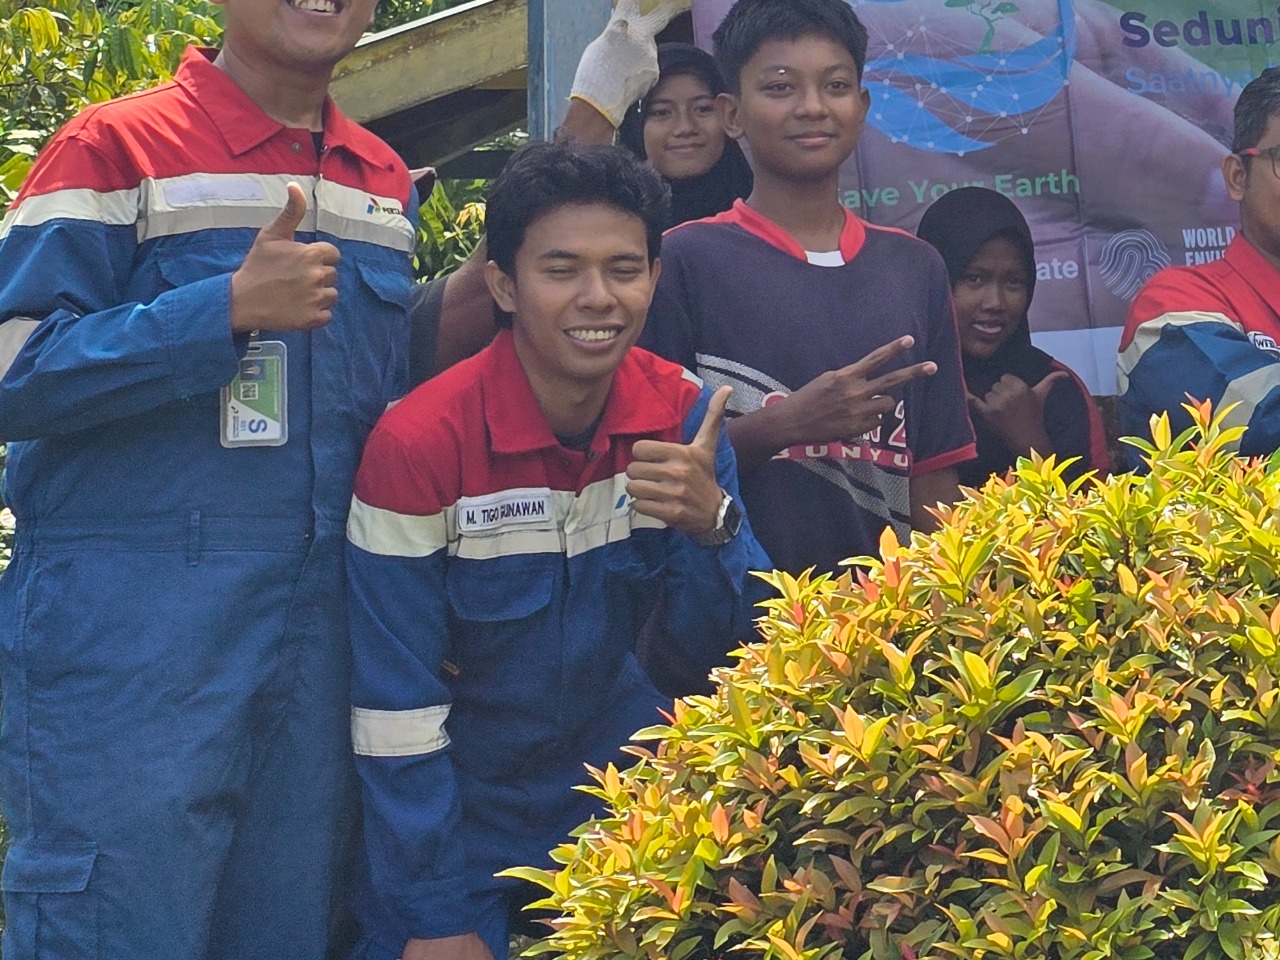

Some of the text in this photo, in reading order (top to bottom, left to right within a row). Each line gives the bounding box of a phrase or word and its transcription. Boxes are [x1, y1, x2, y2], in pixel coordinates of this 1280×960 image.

[842, 186, 900, 209] ave
[995, 169, 1081, 198] Earth
[1182, 226, 1236, 249] WORLD
[248, 418, 268, 434] S
[466, 510, 477, 525] M.
[481, 507, 499, 524] TIGO
